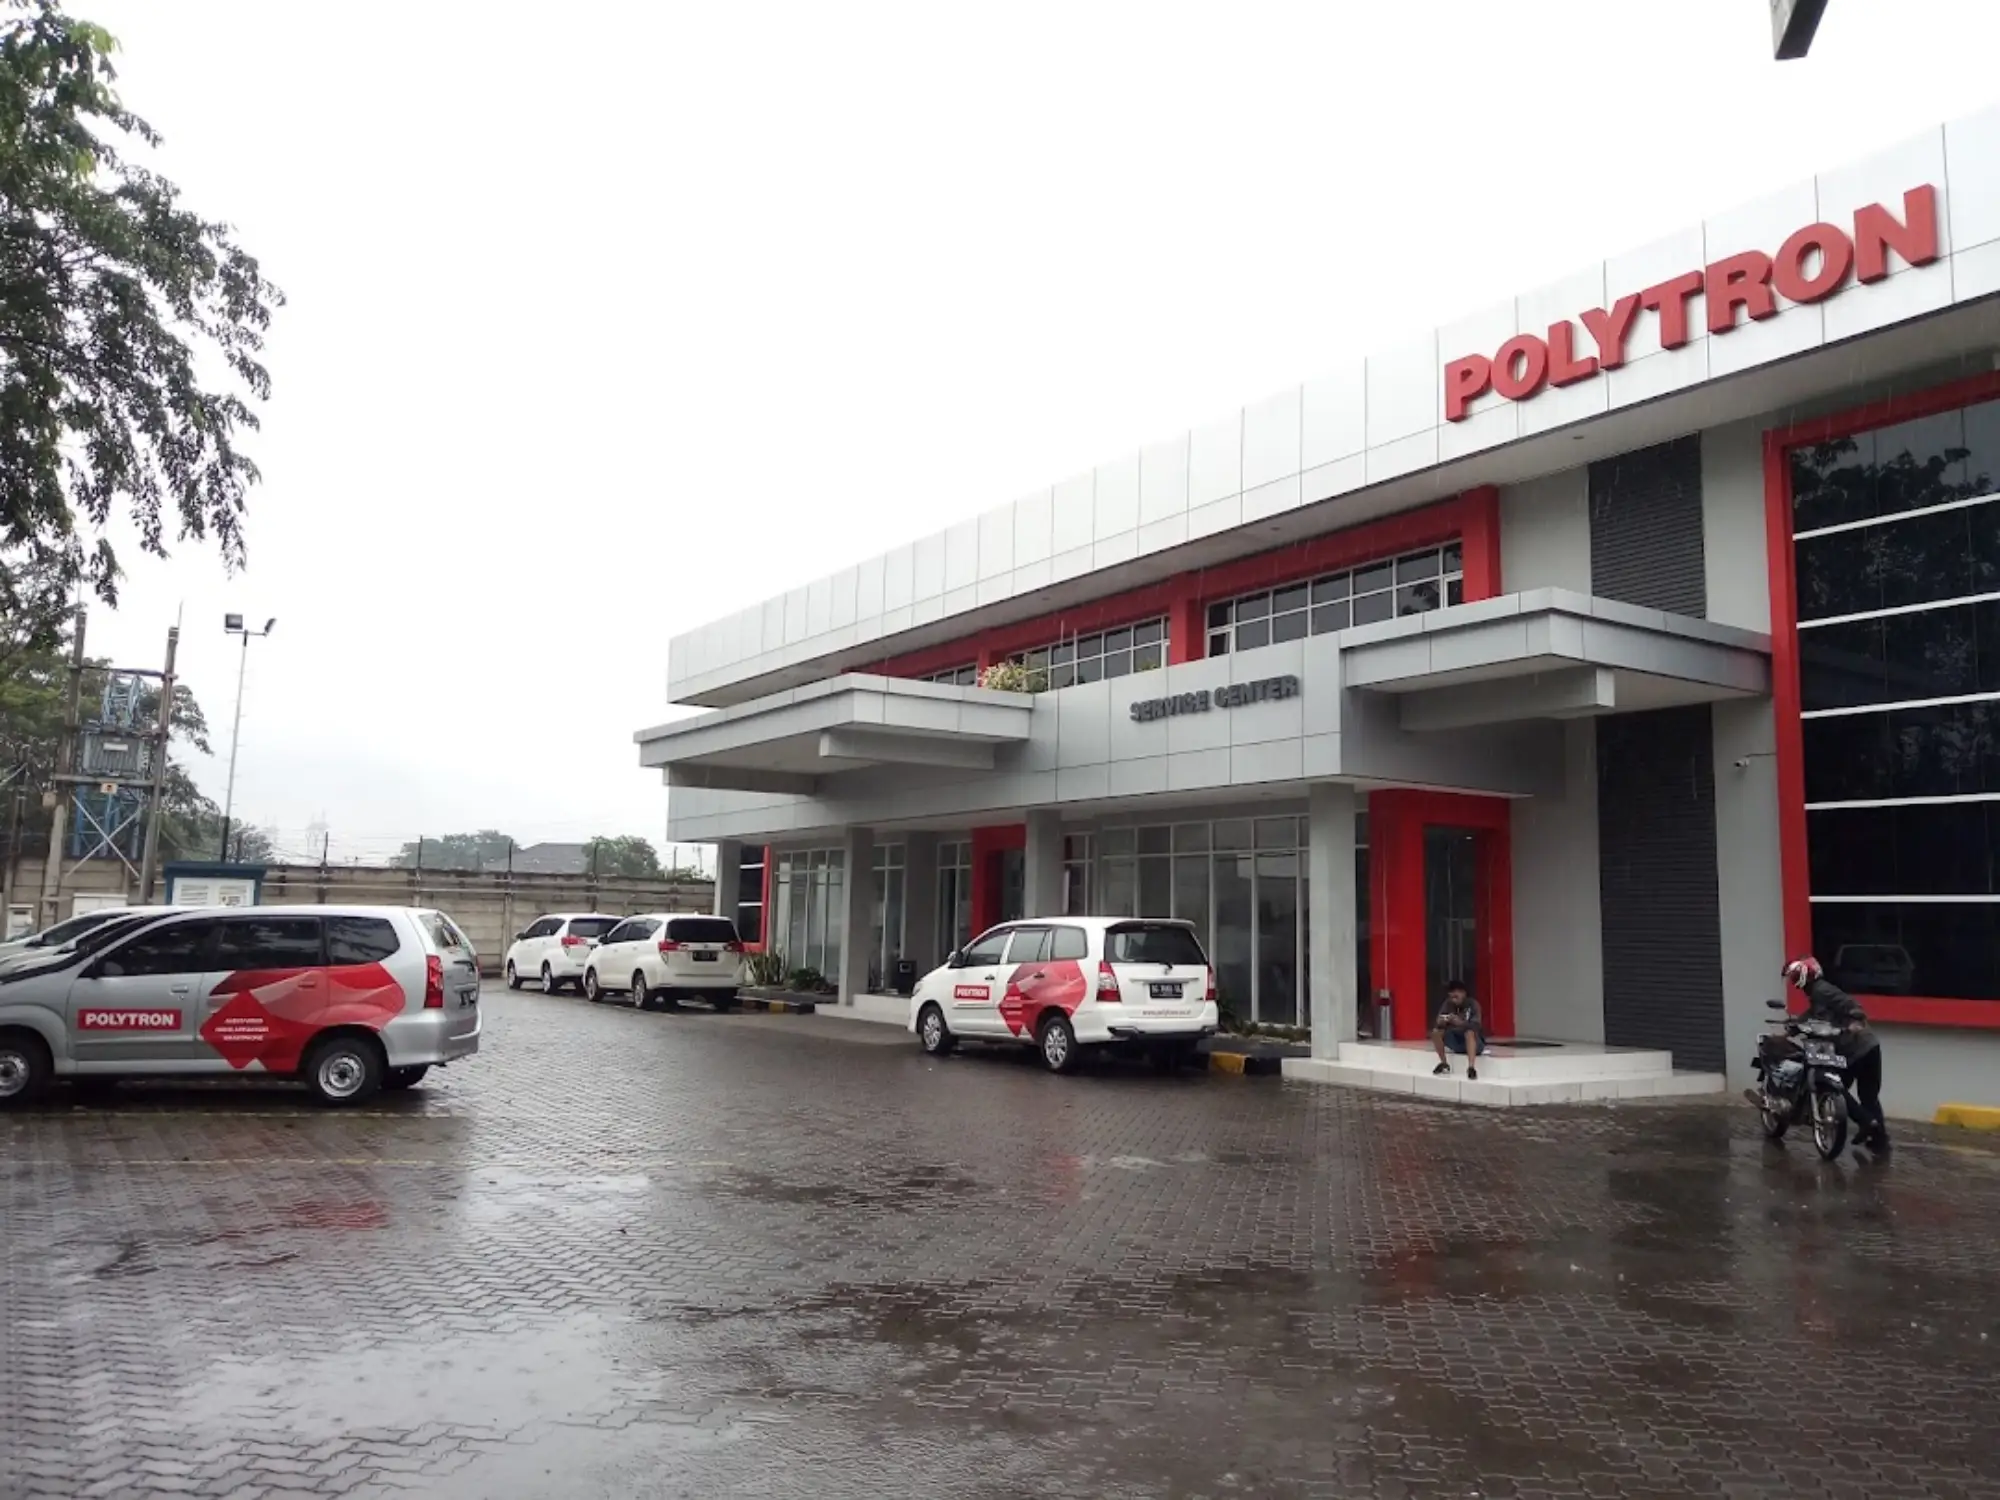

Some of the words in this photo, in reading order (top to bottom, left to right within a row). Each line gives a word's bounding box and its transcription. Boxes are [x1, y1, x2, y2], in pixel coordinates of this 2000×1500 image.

[1445, 183, 1938, 422] POLYTRON
[1130, 689, 1211, 722] SERVICE
[1214, 674, 1300, 708] CENTER
[85, 1012, 175, 1026] POLYTRON
